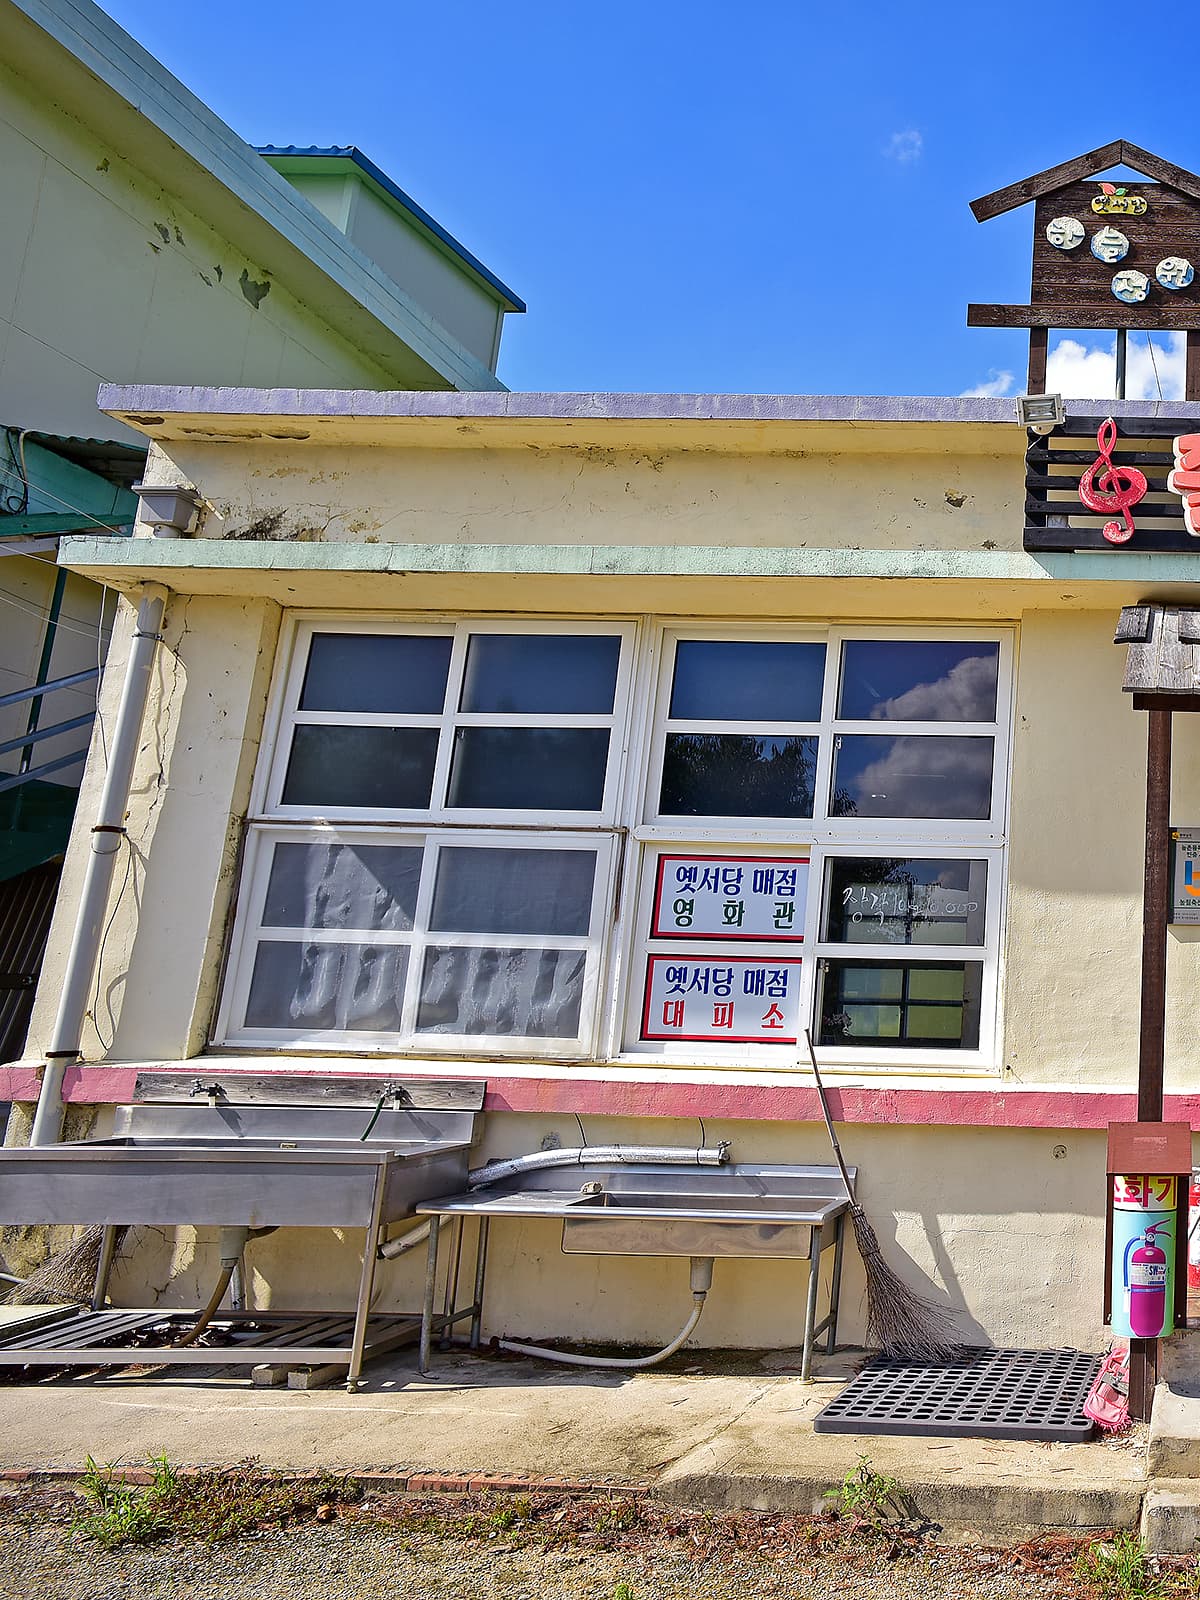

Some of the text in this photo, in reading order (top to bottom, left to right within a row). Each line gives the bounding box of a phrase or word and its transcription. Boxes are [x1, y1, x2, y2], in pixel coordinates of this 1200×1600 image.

[675, 865, 798, 898] 옛서당 매점
[672, 897, 797, 930] 영화관
[664, 965, 789, 998] 옛서당 매점
[661, 1000, 785, 1030] 대피소
